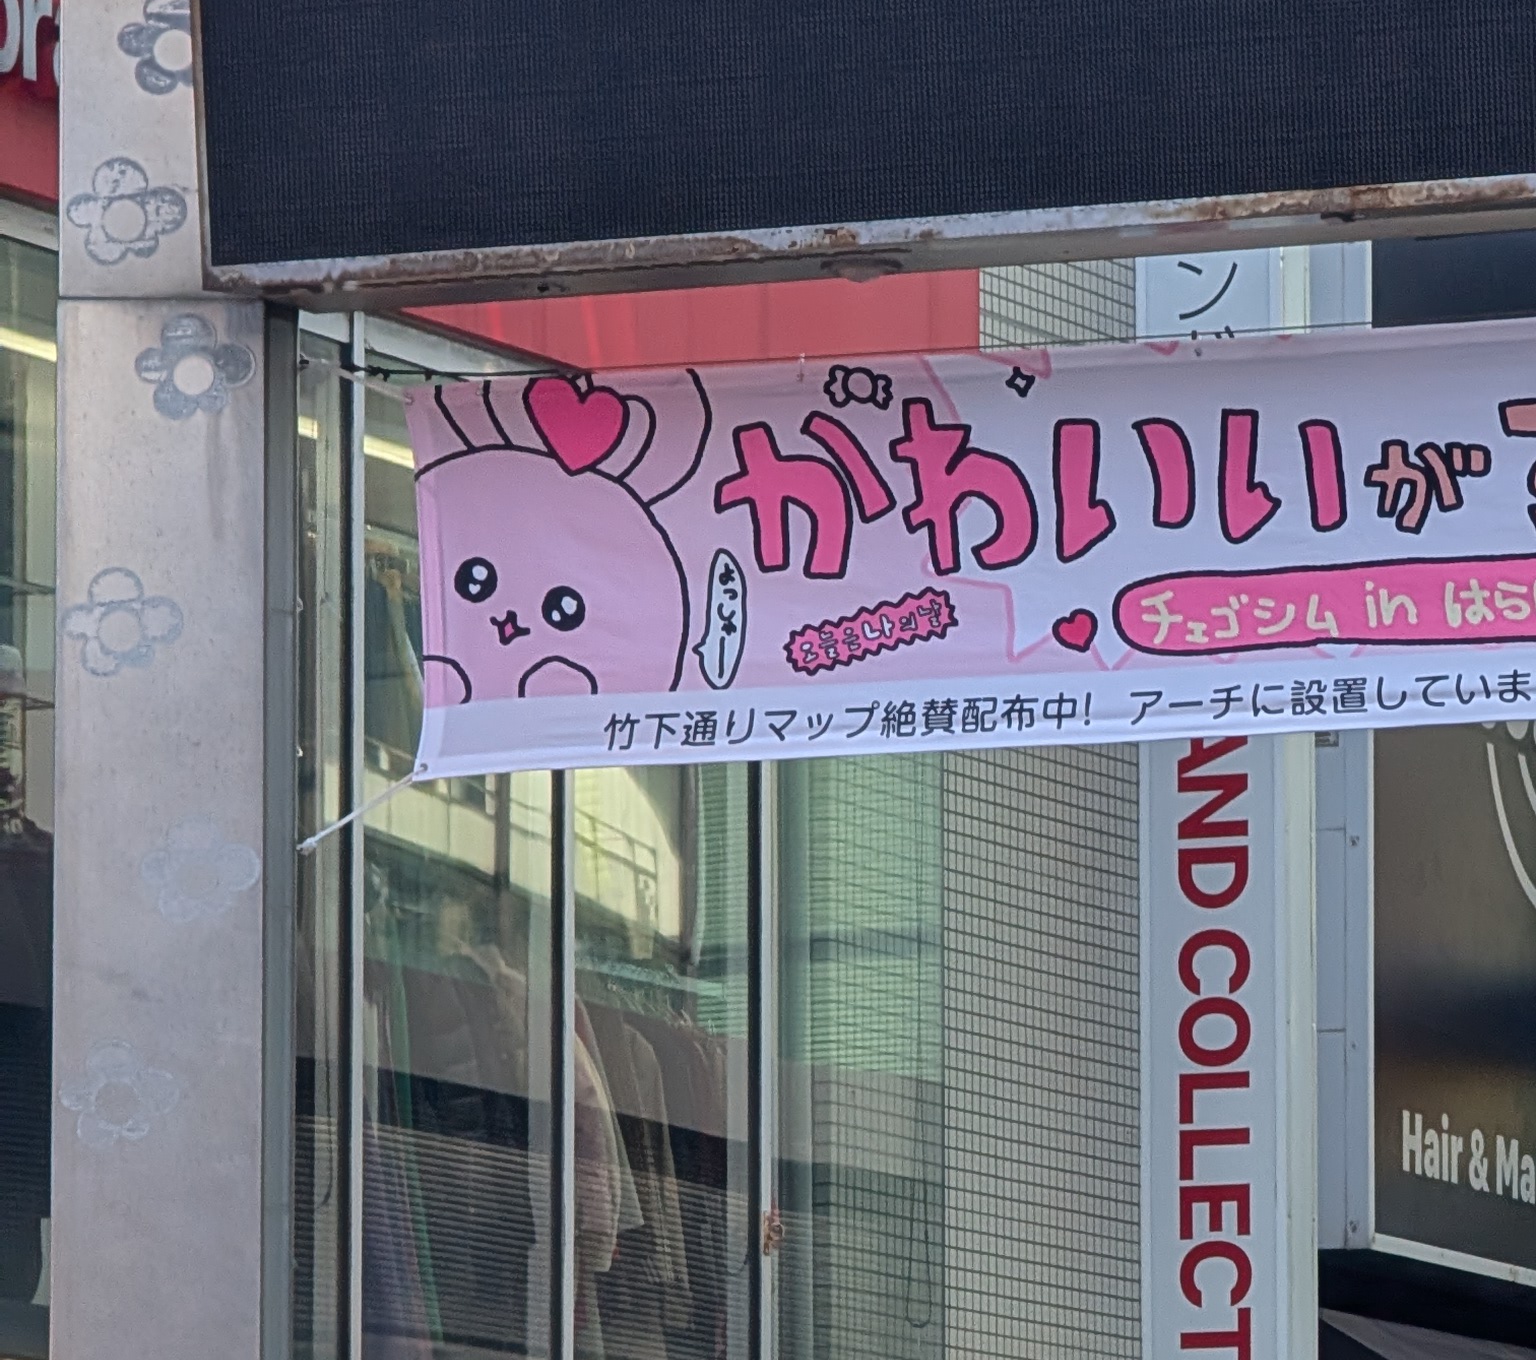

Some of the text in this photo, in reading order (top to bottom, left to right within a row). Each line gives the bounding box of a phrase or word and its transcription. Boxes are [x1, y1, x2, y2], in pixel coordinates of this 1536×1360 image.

[1140, 590, 1339, 645] チェゴシム
[1365, 581, 1419, 628] in
[1401, 1109, 1464, 1185] Hair
[1468, 1128, 1490, 1194] &
